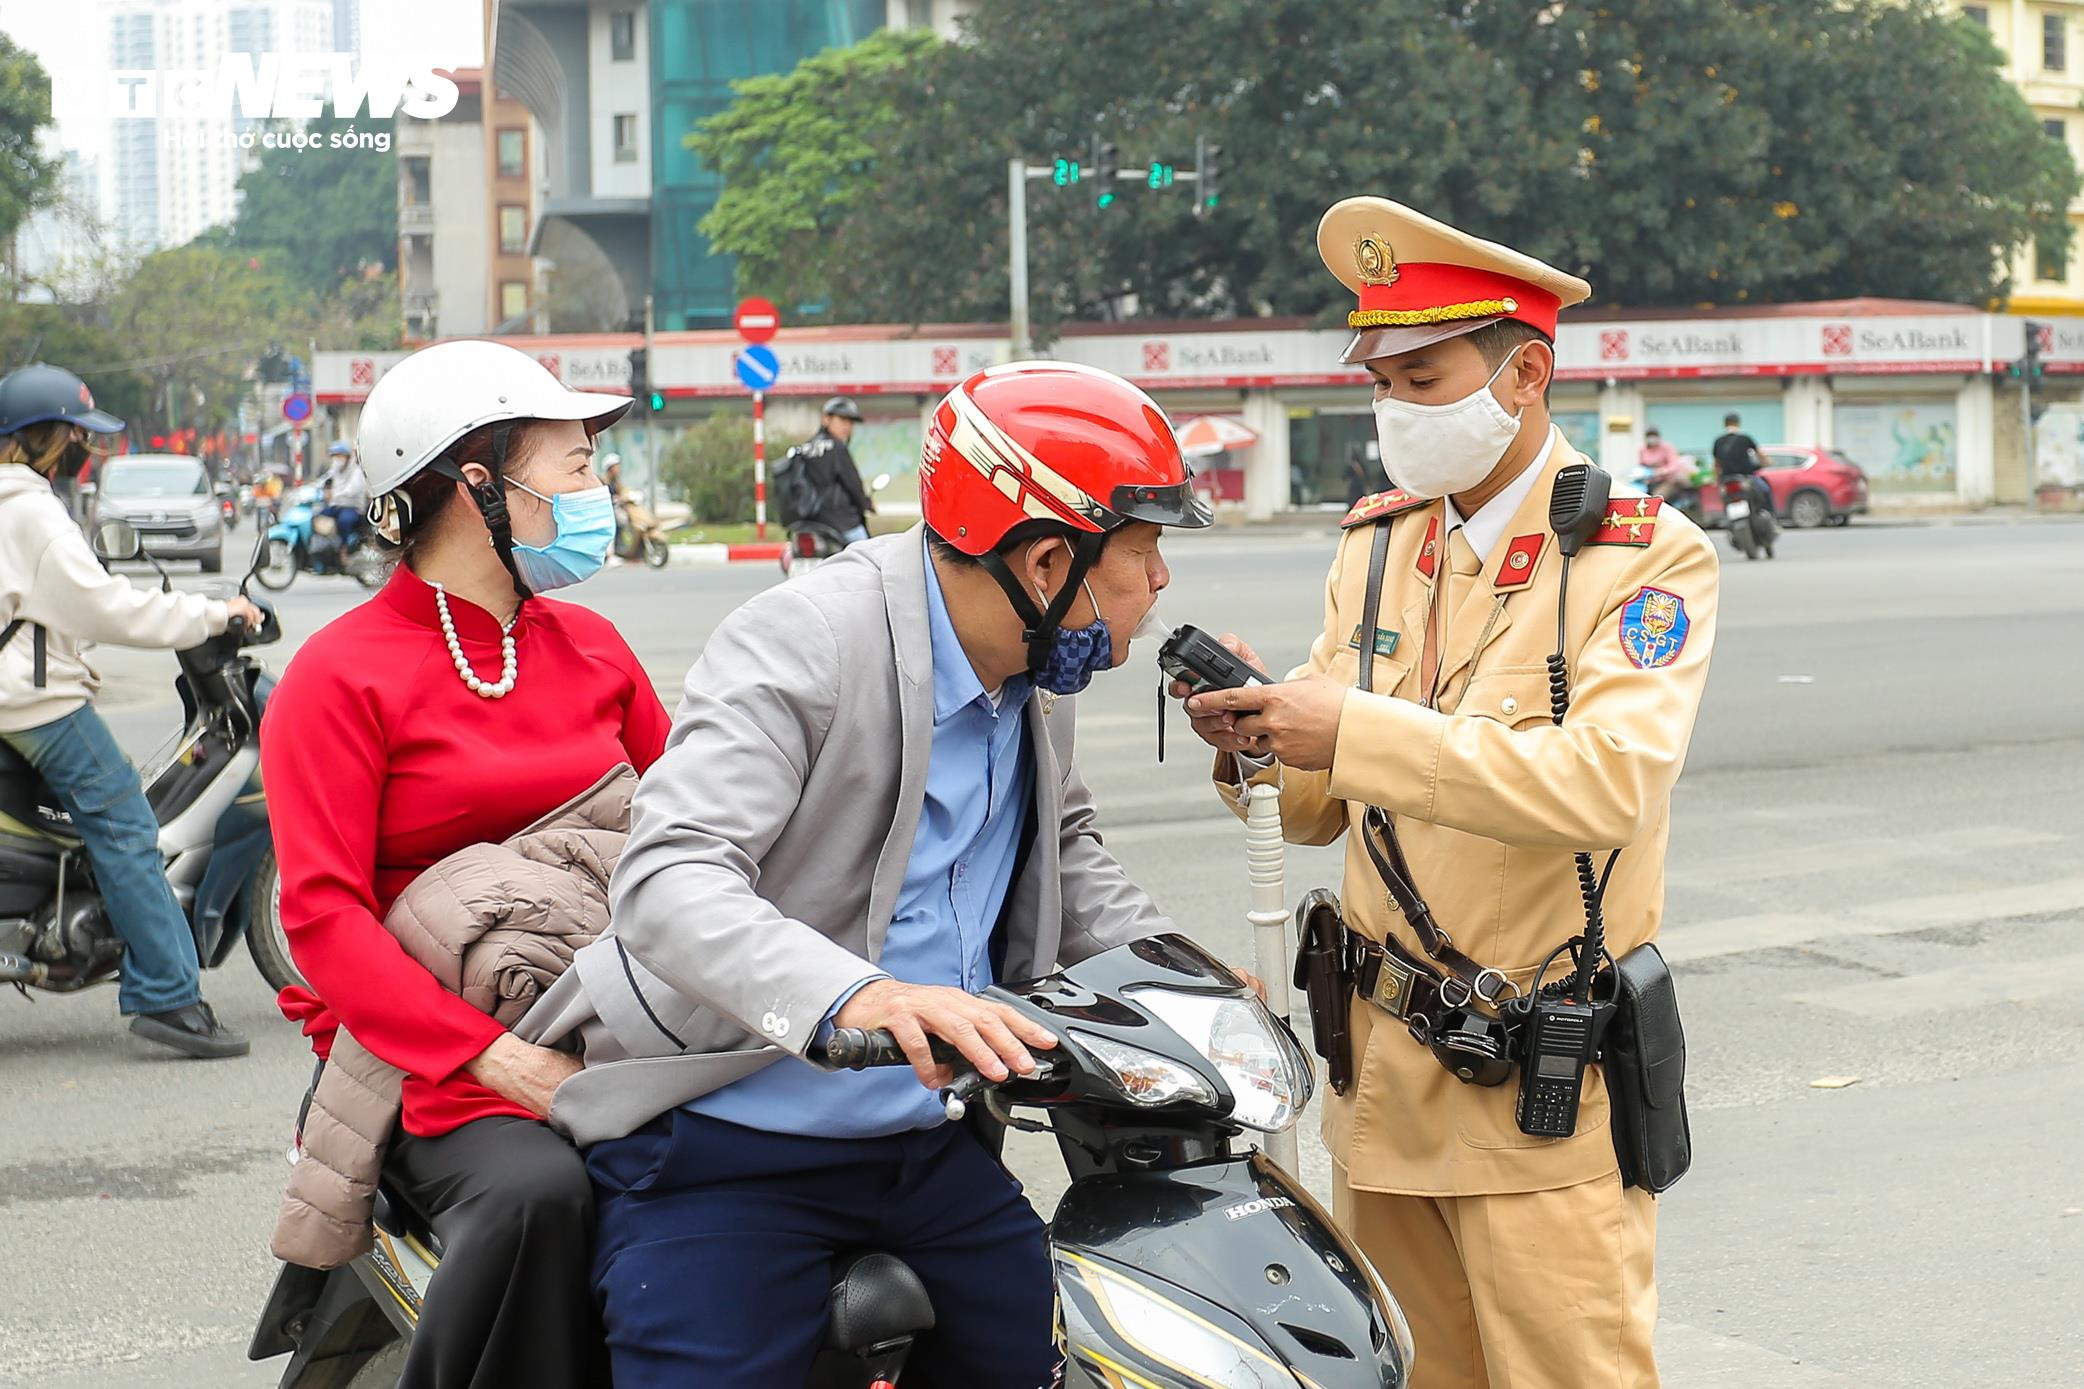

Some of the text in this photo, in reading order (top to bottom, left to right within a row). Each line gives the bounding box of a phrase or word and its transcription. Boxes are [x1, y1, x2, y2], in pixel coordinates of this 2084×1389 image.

[1640, 333, 1743, 355] SeABank
[1860, 327, 1968, 351] SeABank
[779, 353, 854, 376] eABank
[1179, 345, 1273, 367] SeABank
[1626, 627, 1679, 651] CSGT
[1225, 1196, 1296, 1221] HONDA
